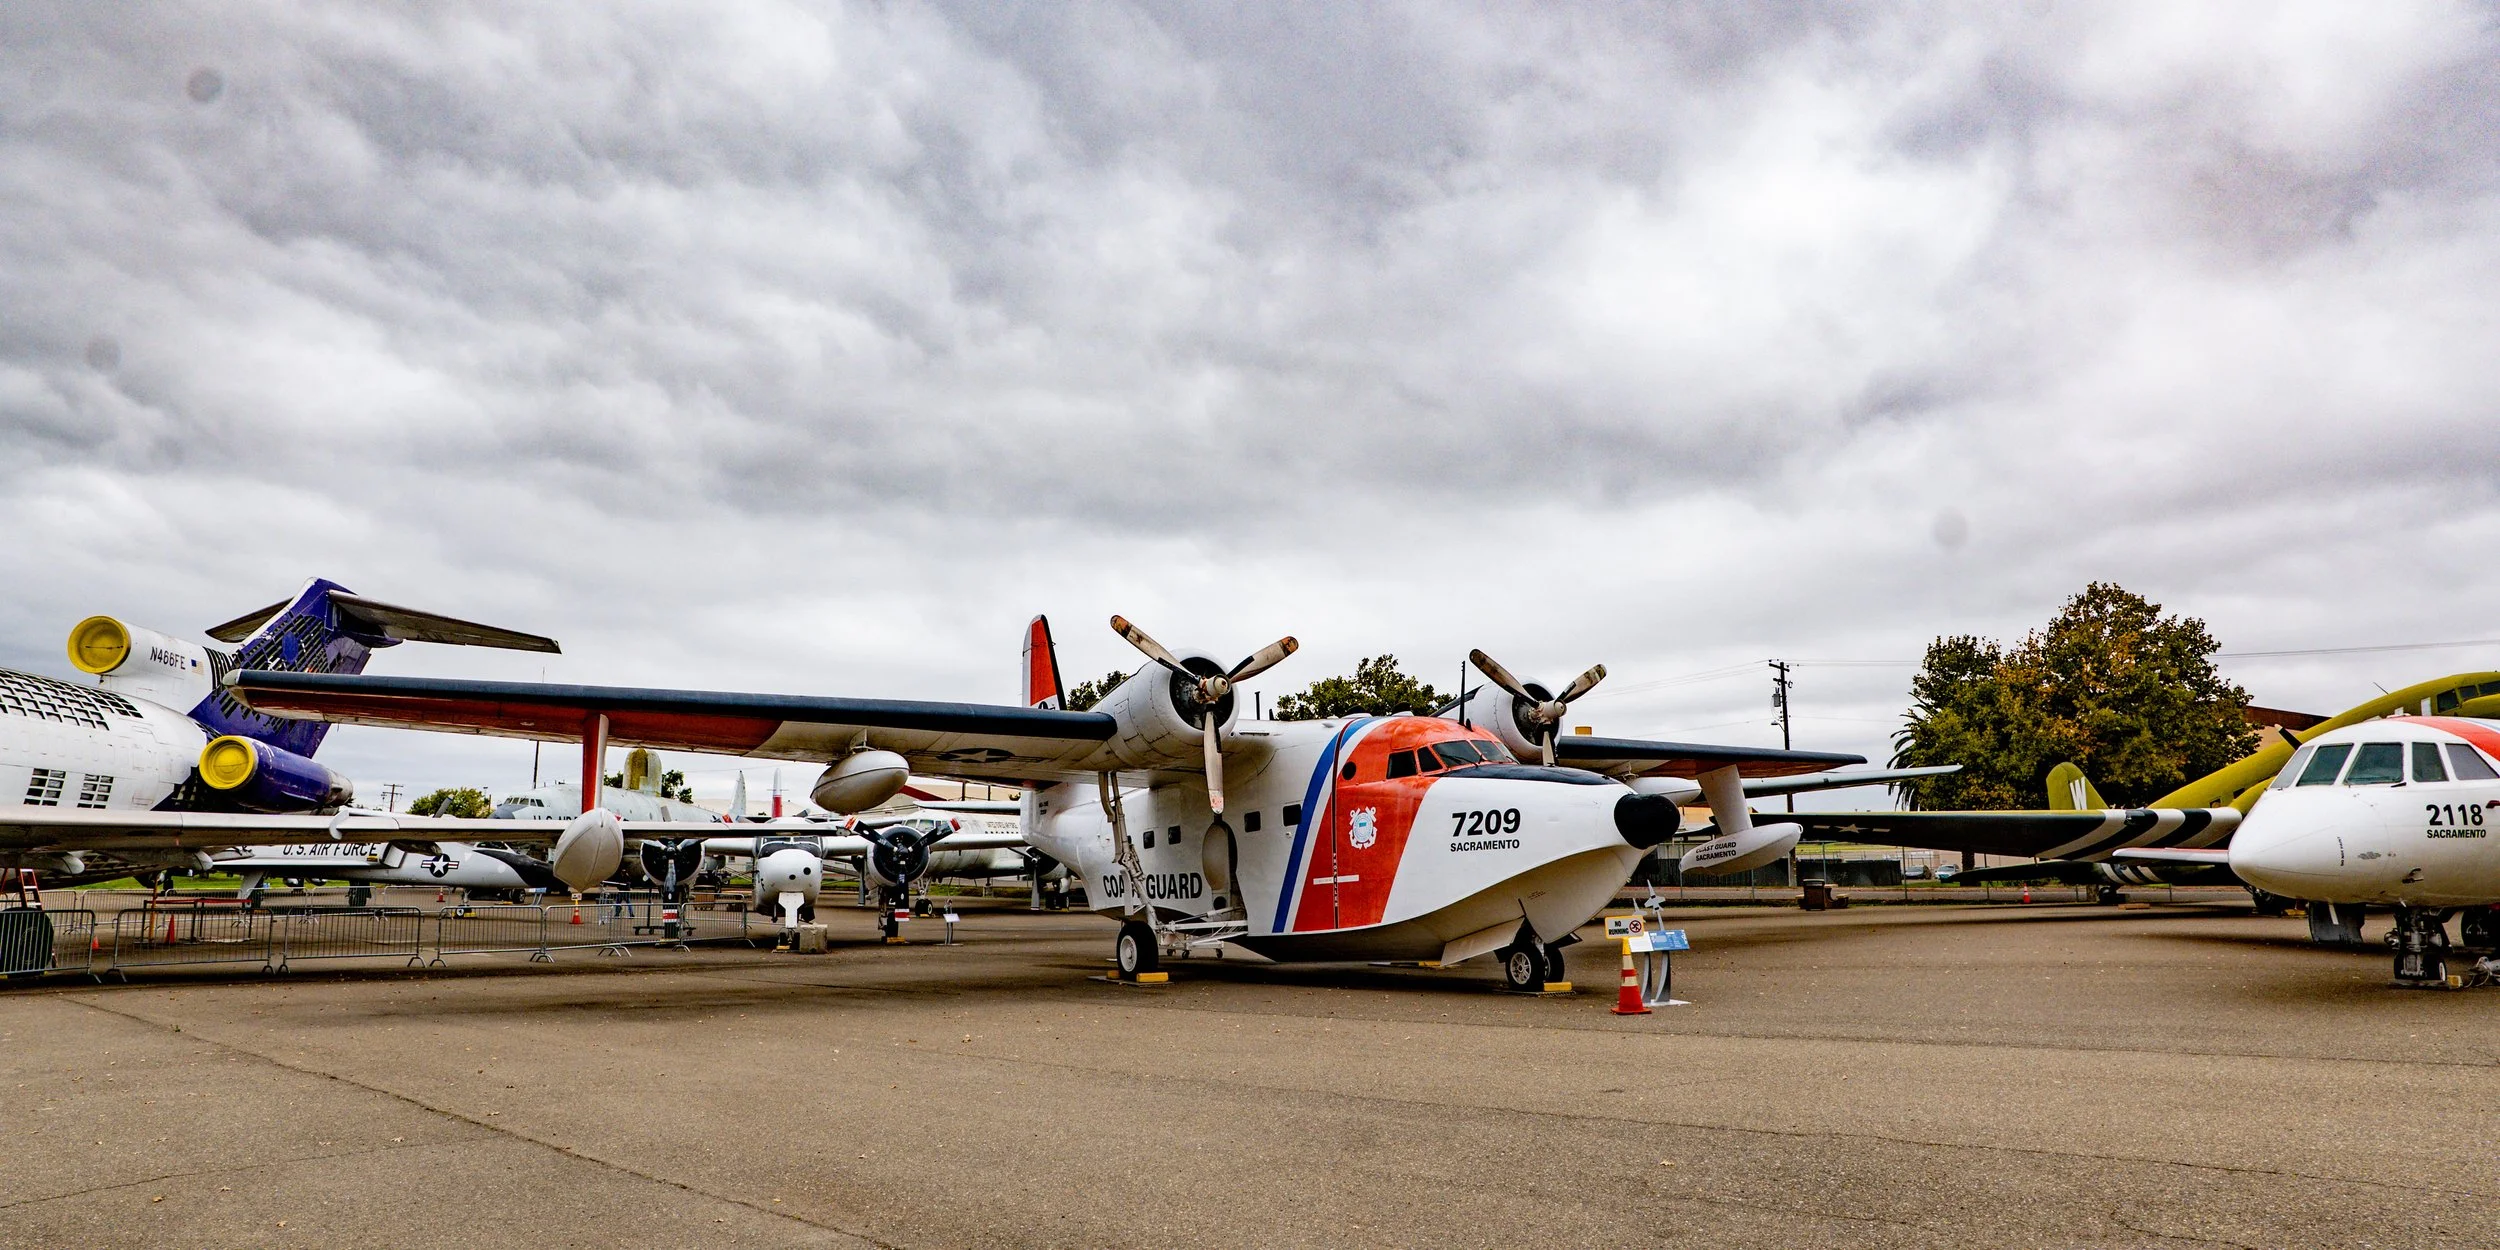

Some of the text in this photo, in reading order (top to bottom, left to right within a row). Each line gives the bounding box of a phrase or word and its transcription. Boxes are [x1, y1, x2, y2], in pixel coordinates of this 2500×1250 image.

[150, 646, 186, 670] N466FE
[2426, 804, 2484, 826] 2118
[1452, 808, 1521, 837] 7209
[2427, 829, 2487, 839] SACRAMENTO
[309, 844, 331, 856] AIR
[1450, 839, 1520, 852] SACRAMENTO
[1714, 842, 1737, 850] GUARD
[1696, 849, 1737, 861] SACRAMENTO
[1103, 872, 1203, 900] COA GUARD
